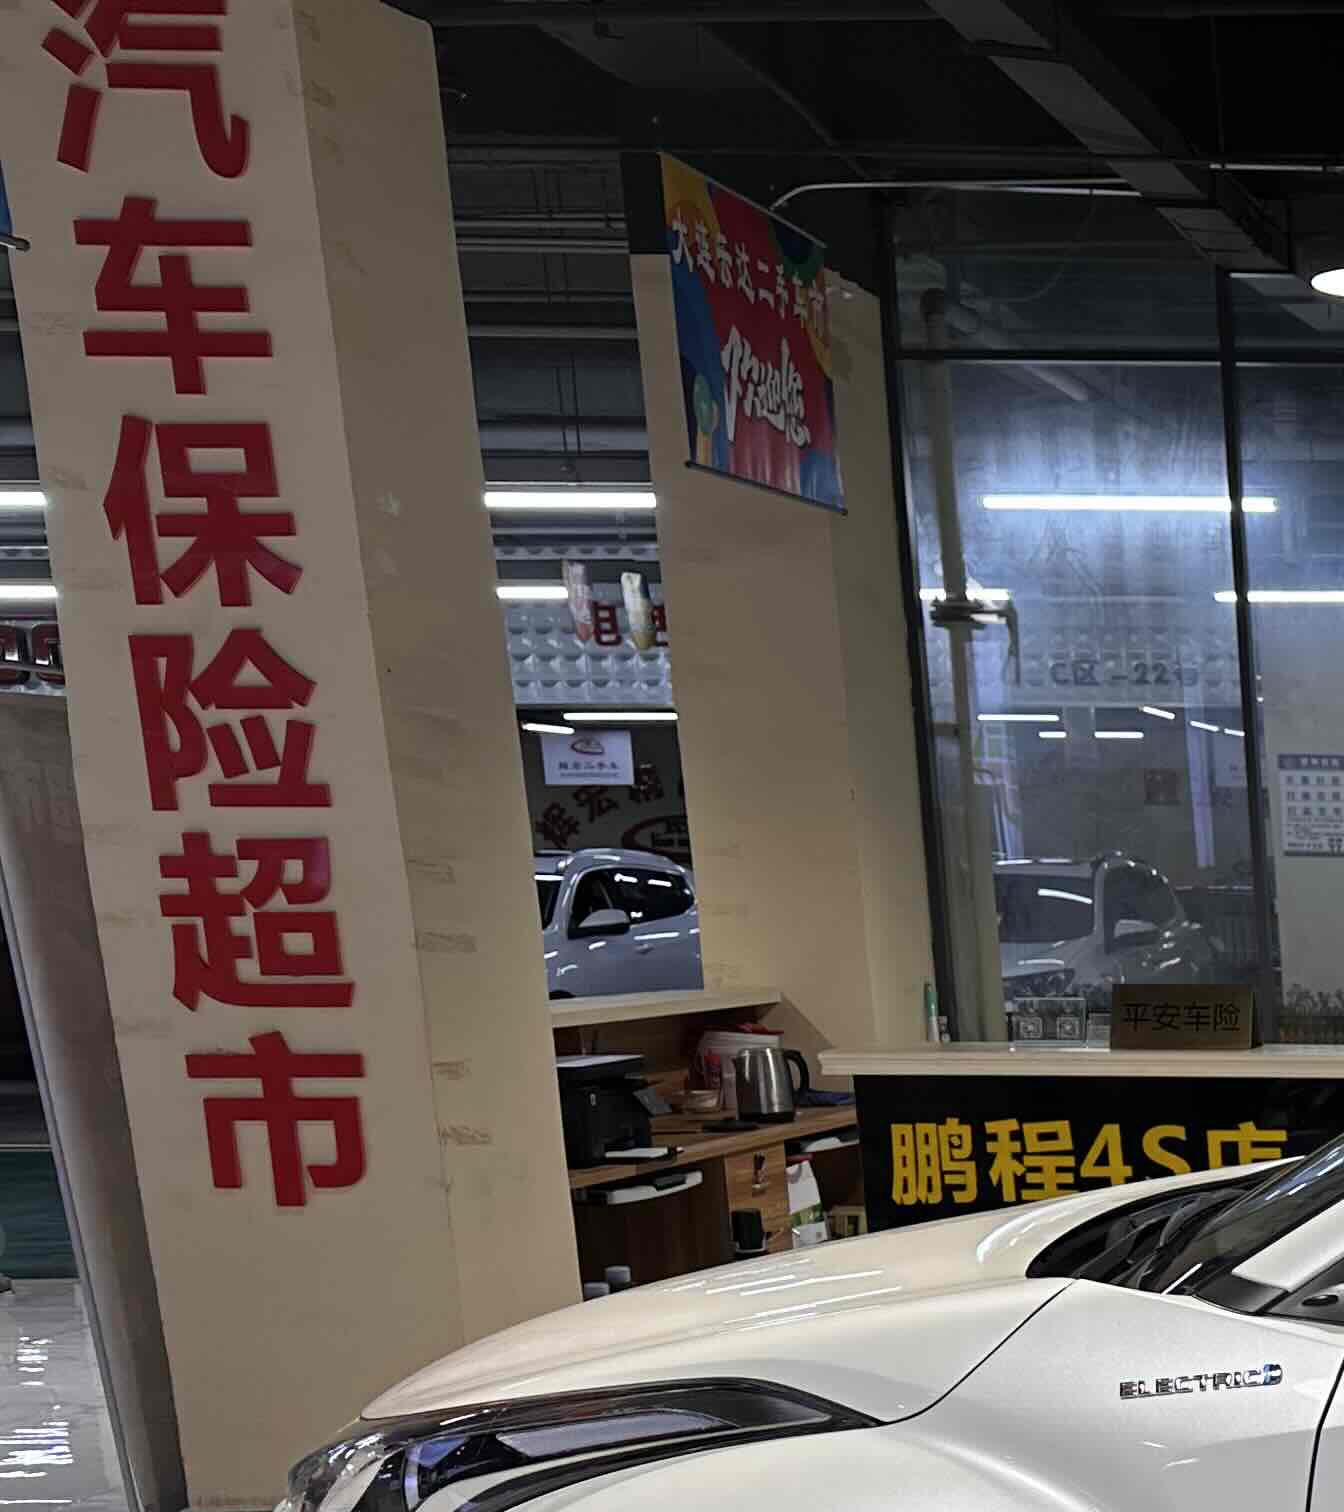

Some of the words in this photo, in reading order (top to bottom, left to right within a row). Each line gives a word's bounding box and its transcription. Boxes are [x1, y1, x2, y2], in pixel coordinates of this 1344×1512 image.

[41, 0, 368, 1208] 汽车保险超市
[1121, 1001, 1242, 1033] 平安车险
